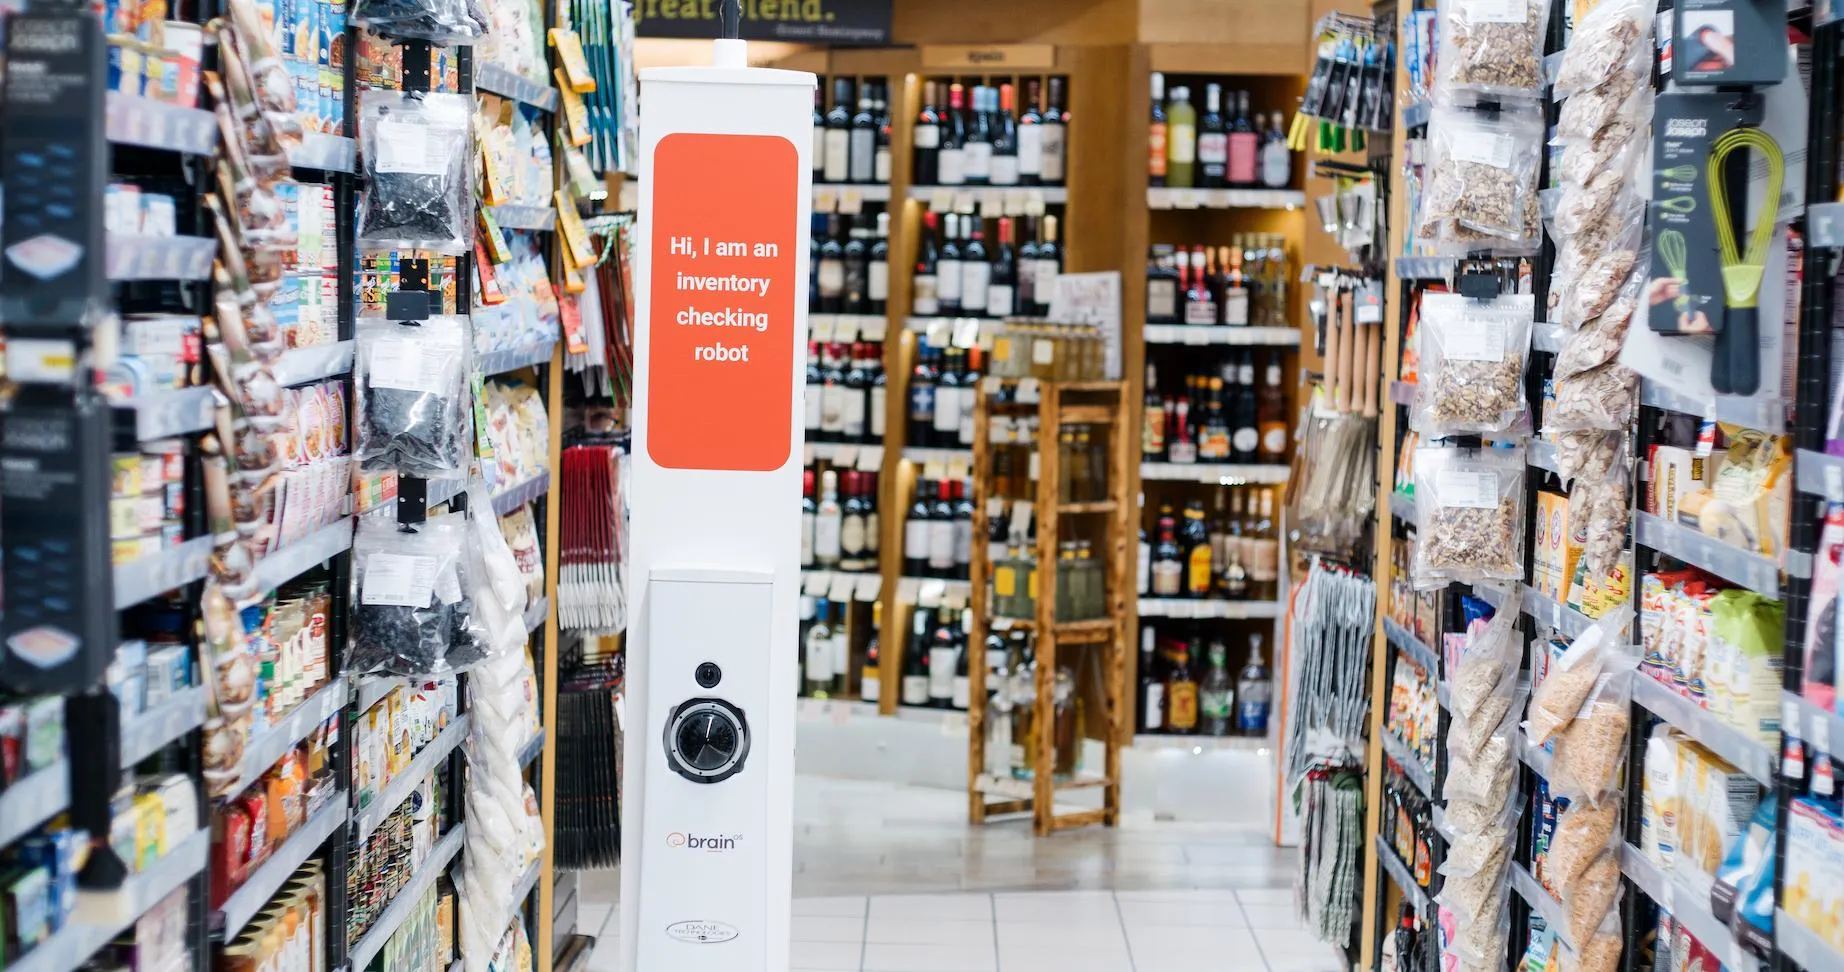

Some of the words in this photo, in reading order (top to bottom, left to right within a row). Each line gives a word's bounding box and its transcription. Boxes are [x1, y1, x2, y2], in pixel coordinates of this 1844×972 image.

[741, 0, 836, 22] lend.
[670, 236, 697, 258] Hi,
[704, 238, 709, 255] I
[716, 241, 747, 257] am
[753, 242, 778, 257] an
[677, 272, 770, 297] inventory
[676, 306, 769, 331] checking
[695, 342, 749, 361] robot
[687, 833, 735, 849] brain
